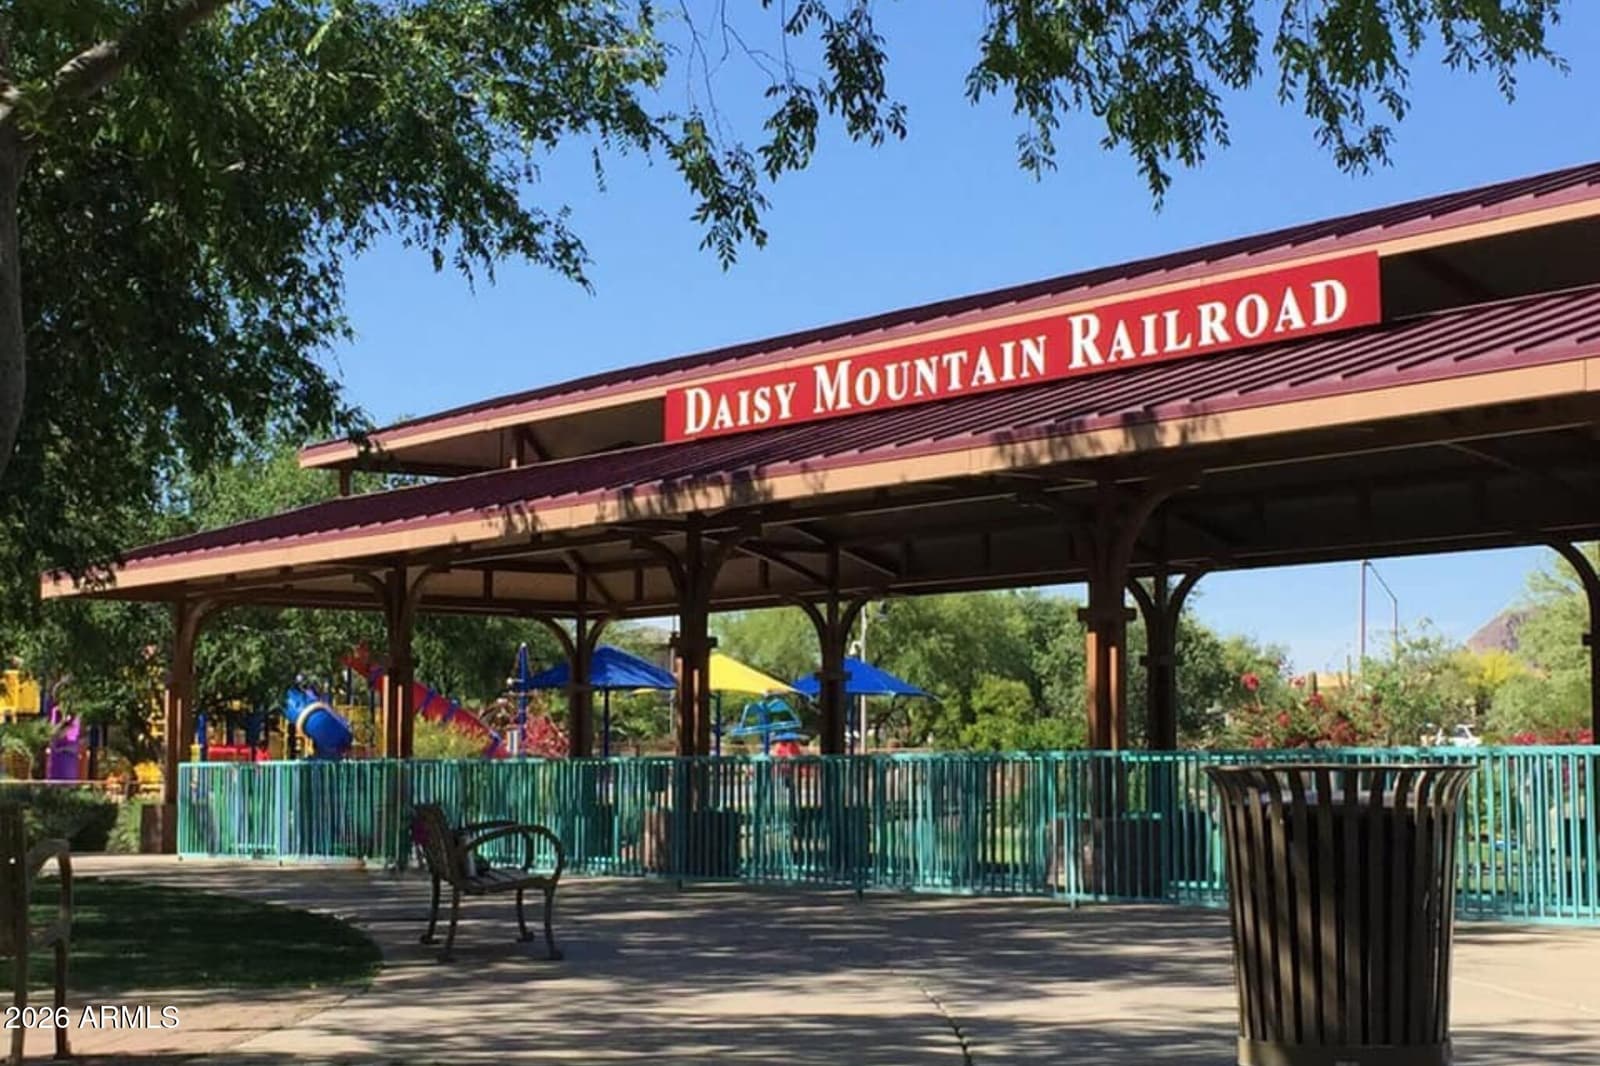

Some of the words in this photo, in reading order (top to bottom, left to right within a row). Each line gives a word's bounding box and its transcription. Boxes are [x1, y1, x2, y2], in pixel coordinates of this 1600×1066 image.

[684, 382, 796, 435] DAISY
[813, 335, 1047, 414] MOUNTAIN
[1068, 279, 1348, 369] RAILROAD
